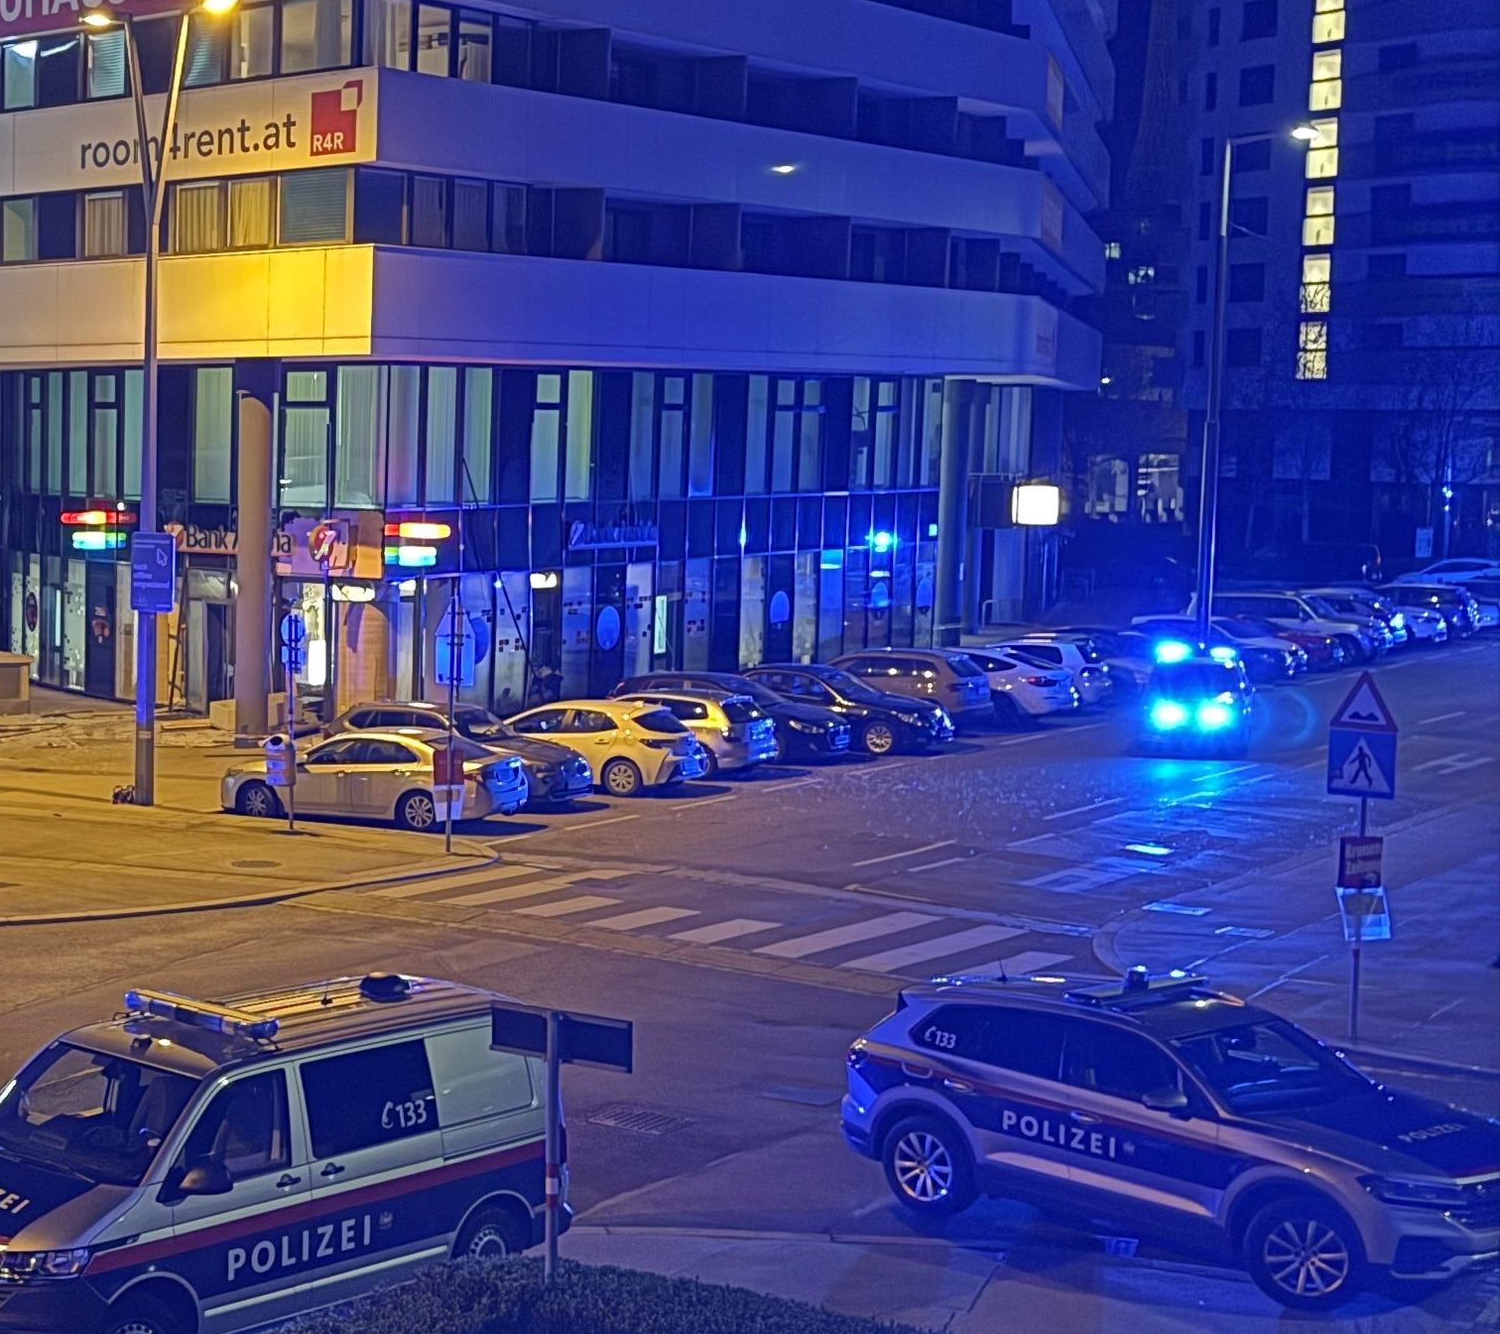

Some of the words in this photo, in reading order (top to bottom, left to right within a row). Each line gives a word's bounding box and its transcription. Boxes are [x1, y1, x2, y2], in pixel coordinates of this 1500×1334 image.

[312, 131, 344, 153] R4R
[186, 526, 229, 549] Bank
[935, 1030, 957, 1049] 133
[395, 1099, 428, 1128] 133
[1002, 1109, 1116, 1158] POLIZEI
[1397, 1123, 1466, 1143] POLIZEI
[227, 1215, 371, 1281] POLIZEI
